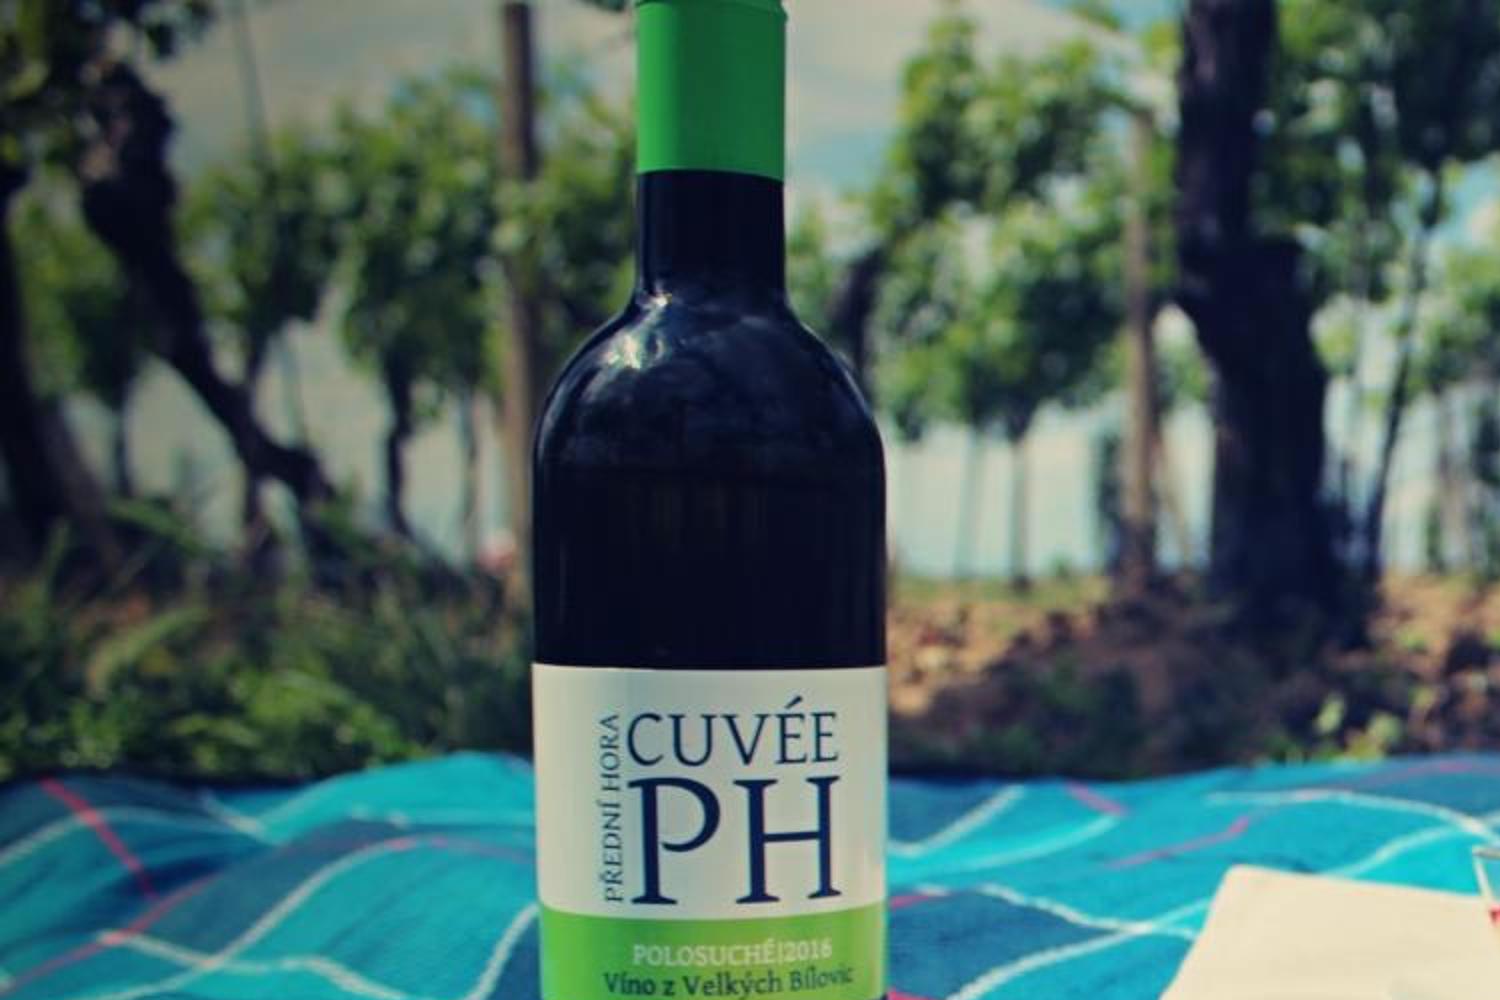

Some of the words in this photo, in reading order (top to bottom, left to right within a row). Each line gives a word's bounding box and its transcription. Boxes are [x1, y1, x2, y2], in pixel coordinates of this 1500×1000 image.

[599, 714, 622, 792] HORA
[627, 696, 839, 767] CUVÉE
[596, 799, 624, 902] PŘEDNÍ
[627, 775, 842, 905] PH
[603, 971, 656, 996] Víno
[661, 977, 676, 997] z
